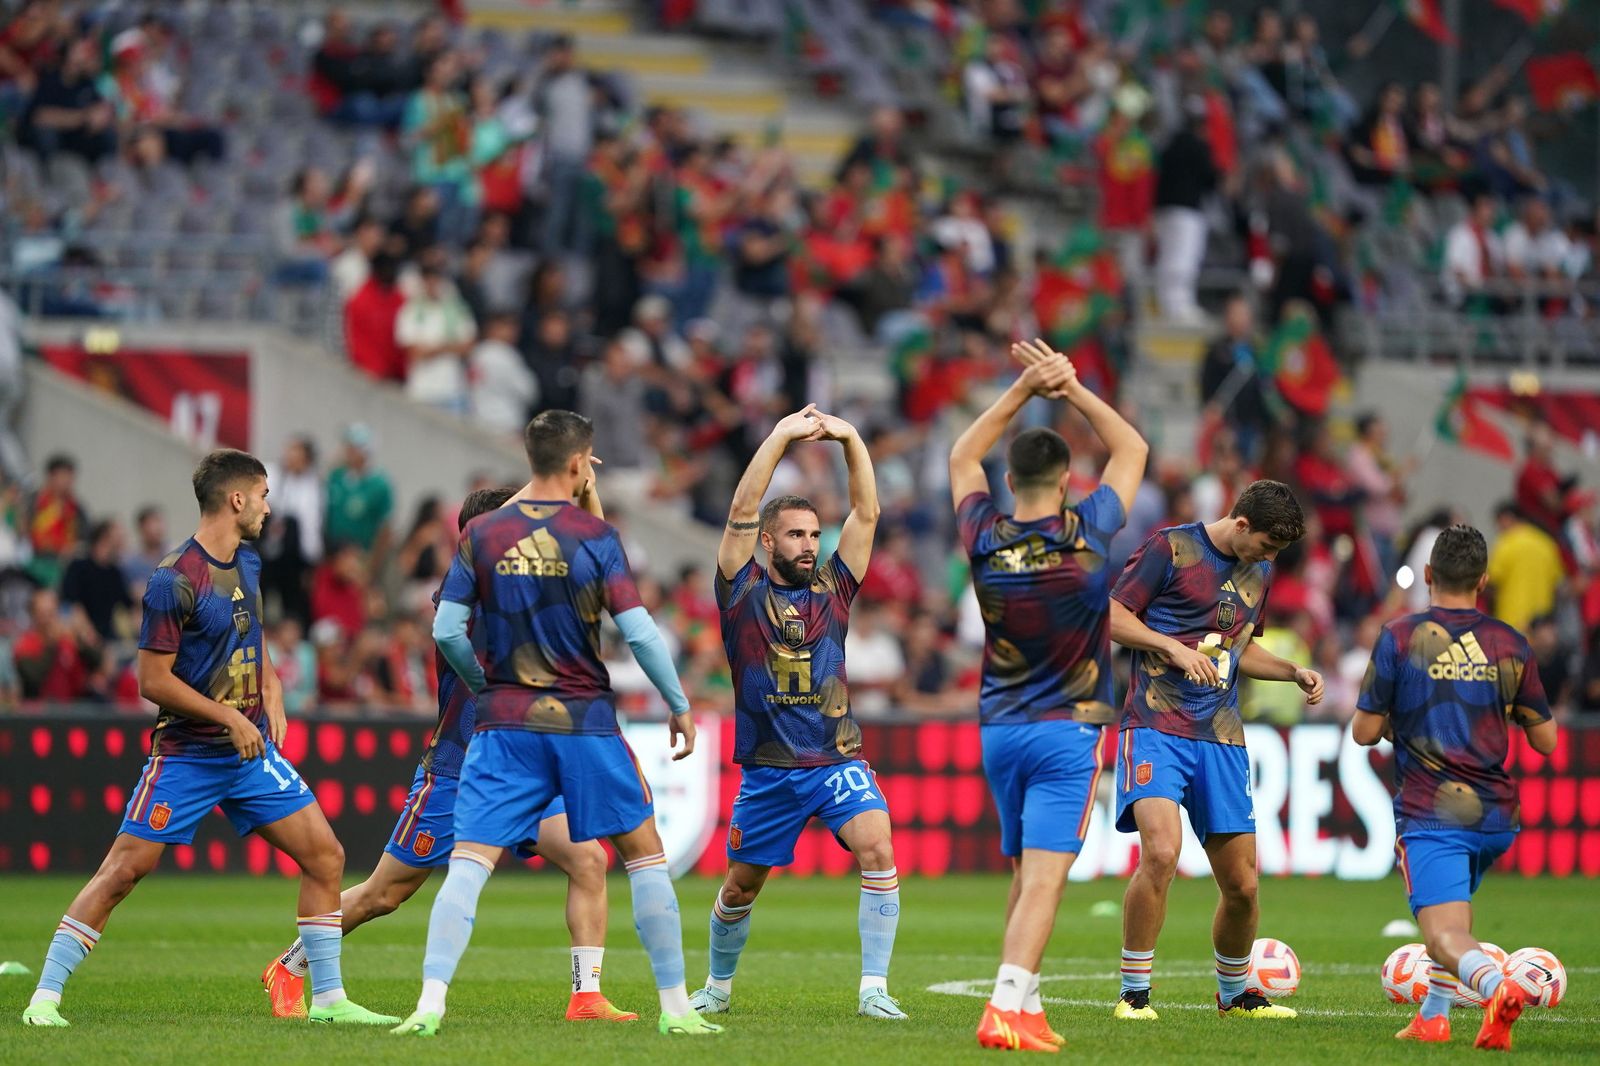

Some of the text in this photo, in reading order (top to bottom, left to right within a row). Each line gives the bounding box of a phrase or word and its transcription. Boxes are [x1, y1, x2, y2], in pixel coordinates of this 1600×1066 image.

[495, 556, 569, 576] adidas
[988, 551, 1062, 573] adidas
[771, 650, 811, 693] fi
[1427, 662, 1498, 682] adidas
[766, 693, 822, 705] network
[263, 751, 299, 791] 11
[824, 766, 871, 805] 20
